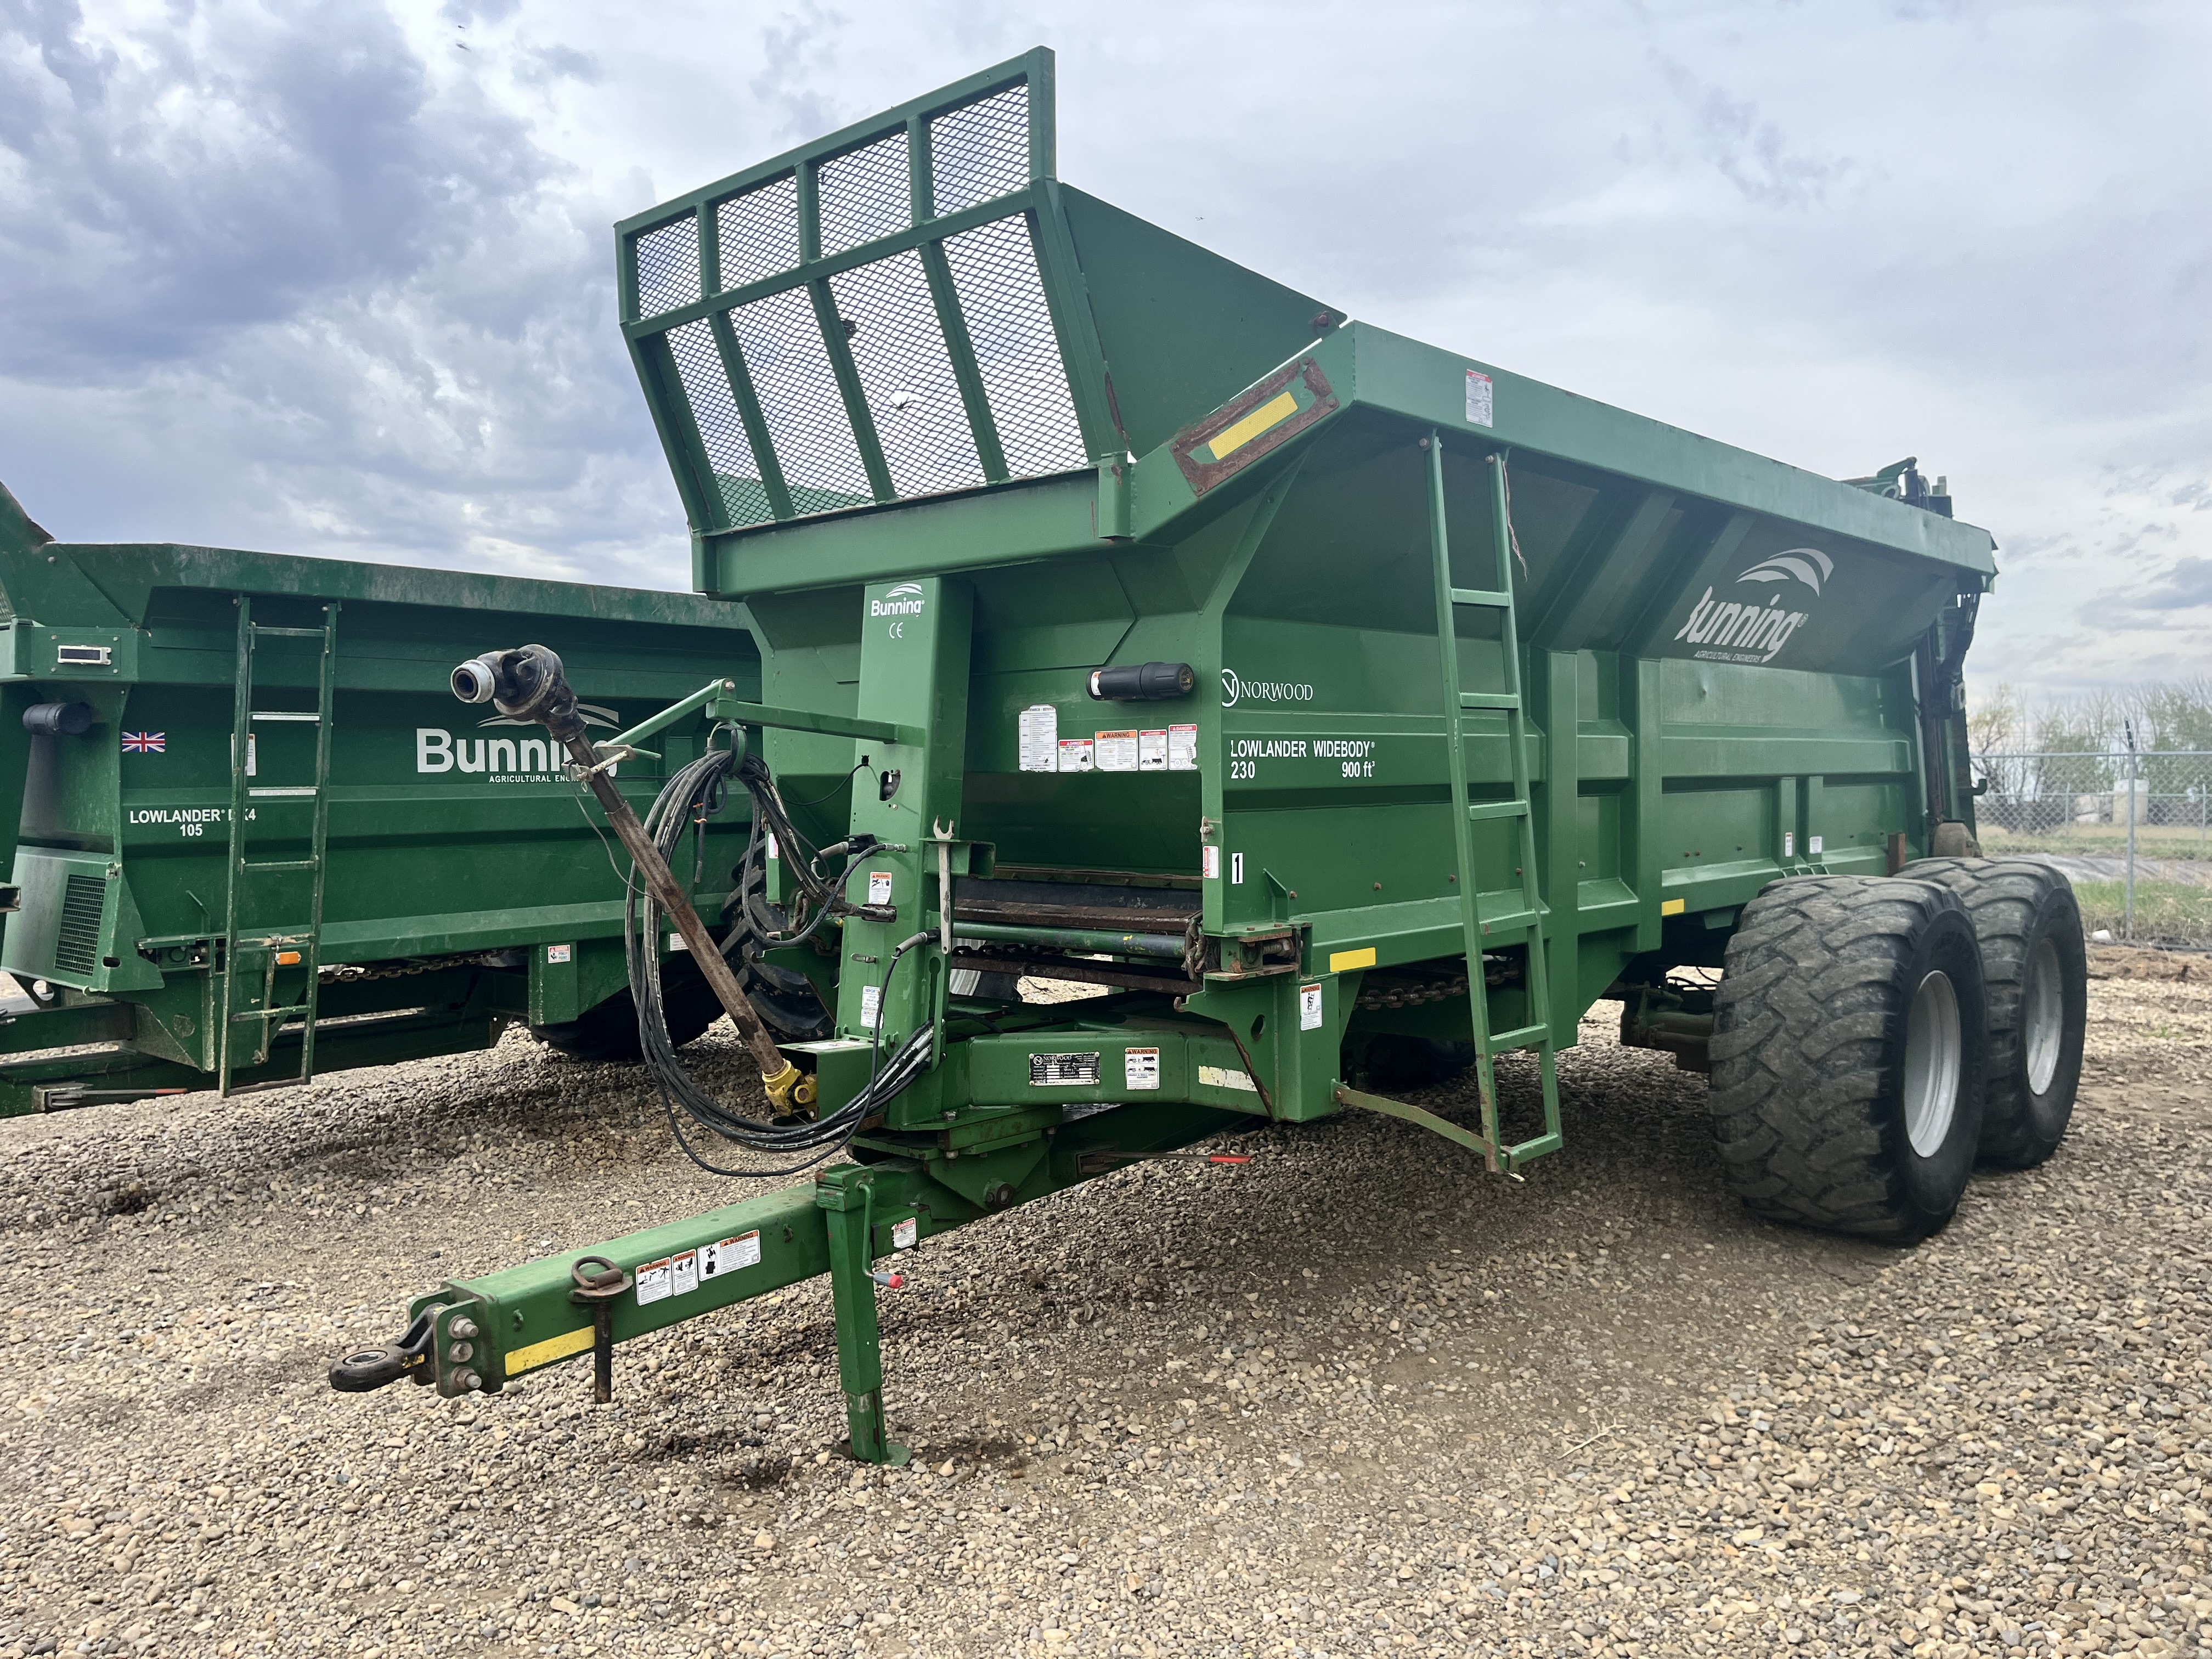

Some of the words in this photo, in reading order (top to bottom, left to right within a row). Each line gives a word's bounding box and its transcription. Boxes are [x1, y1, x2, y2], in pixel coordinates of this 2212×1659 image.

[889, 622, 904, 639] CE
[1240, 681, 1313, 702] NORWOOD
[416, 728, 617, 777] Bunni
[1231, 740, 1307, 758] LOWLANDER
[1231, 761, 1256, 779] 230
[1341, 761, 1361, 778] 900
[489, 775, 551, 783] AGRICULTURAL
[129, 809, 221, 823] LOWLANDER
[179, 823, 203, 837] 105
[1234, 854, 1240, 883] 1
[645, 1261, 667, 1272] WARNING
